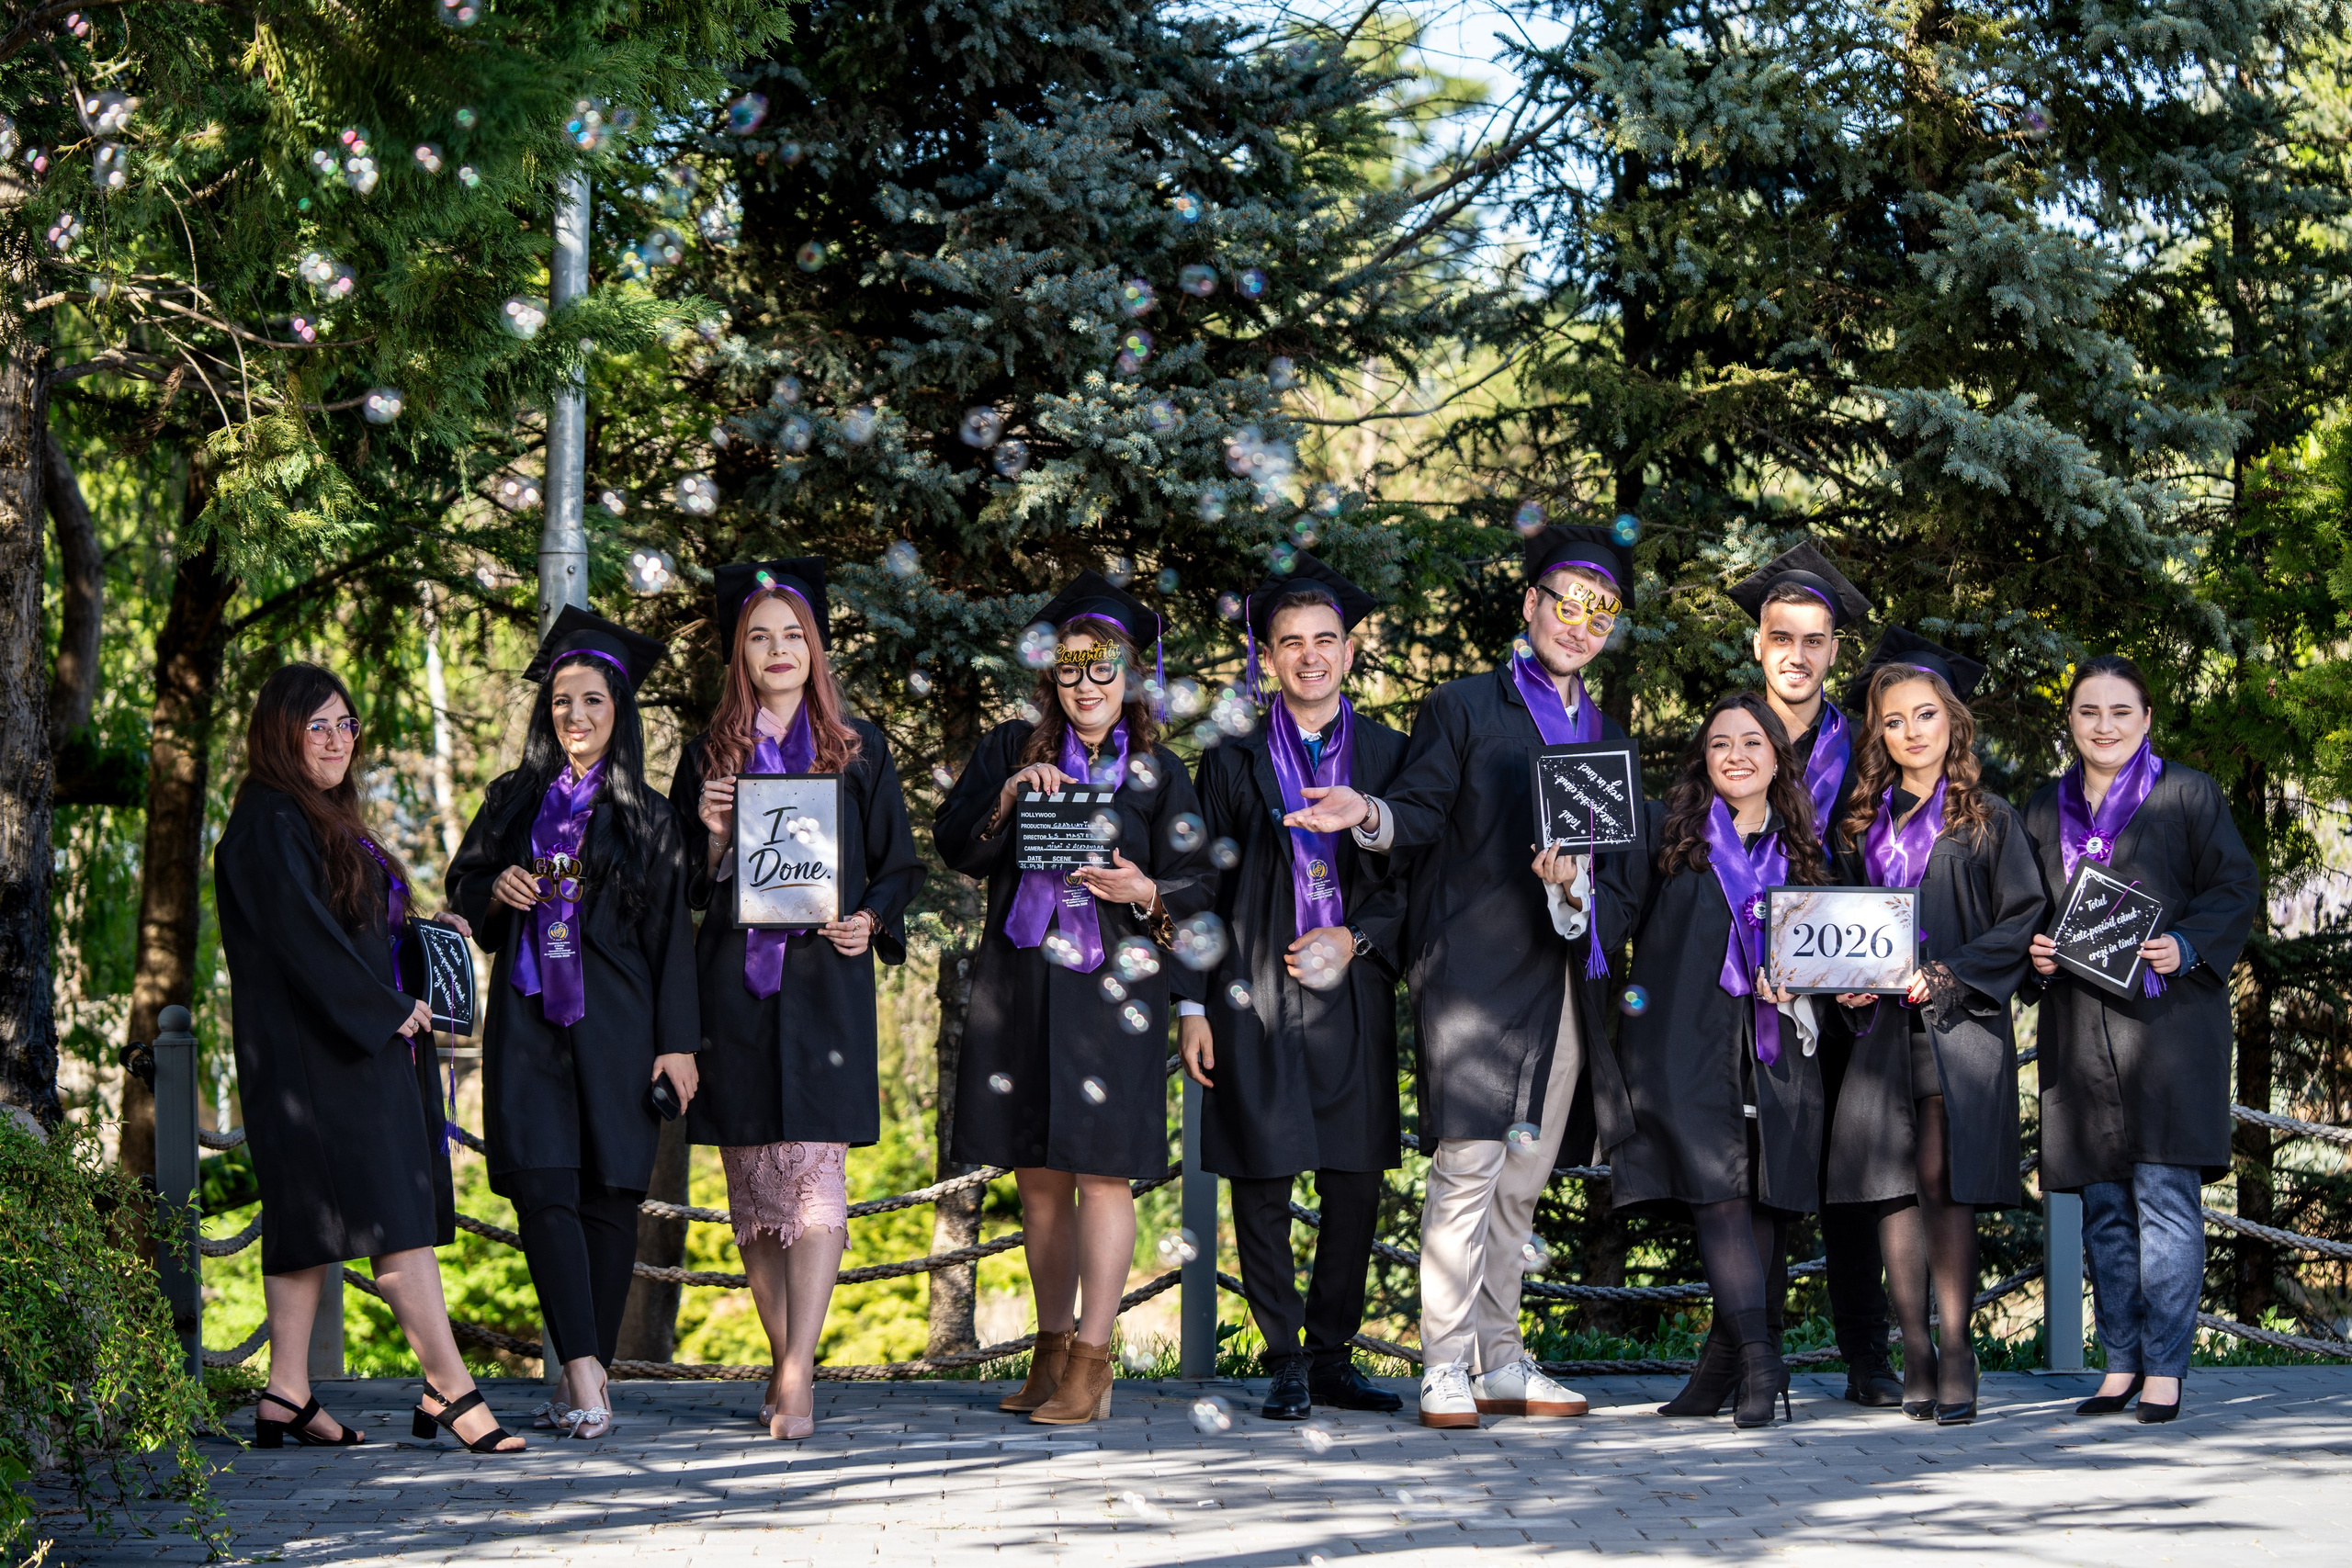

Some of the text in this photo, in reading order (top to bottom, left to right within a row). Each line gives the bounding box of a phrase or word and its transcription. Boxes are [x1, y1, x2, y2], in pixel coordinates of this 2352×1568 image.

[1568, 582, 1623, 615] GRAD
[1054, 639, 1121, 669] Congrats
[1558, 810, 1581, 830] Totul
[534, 858, 582, 878] GRAD
[749, 847, 831, 887] Done.
[2086, 894, 2108, 912] Totul
[1792, 923, 1893, 958] 2026
